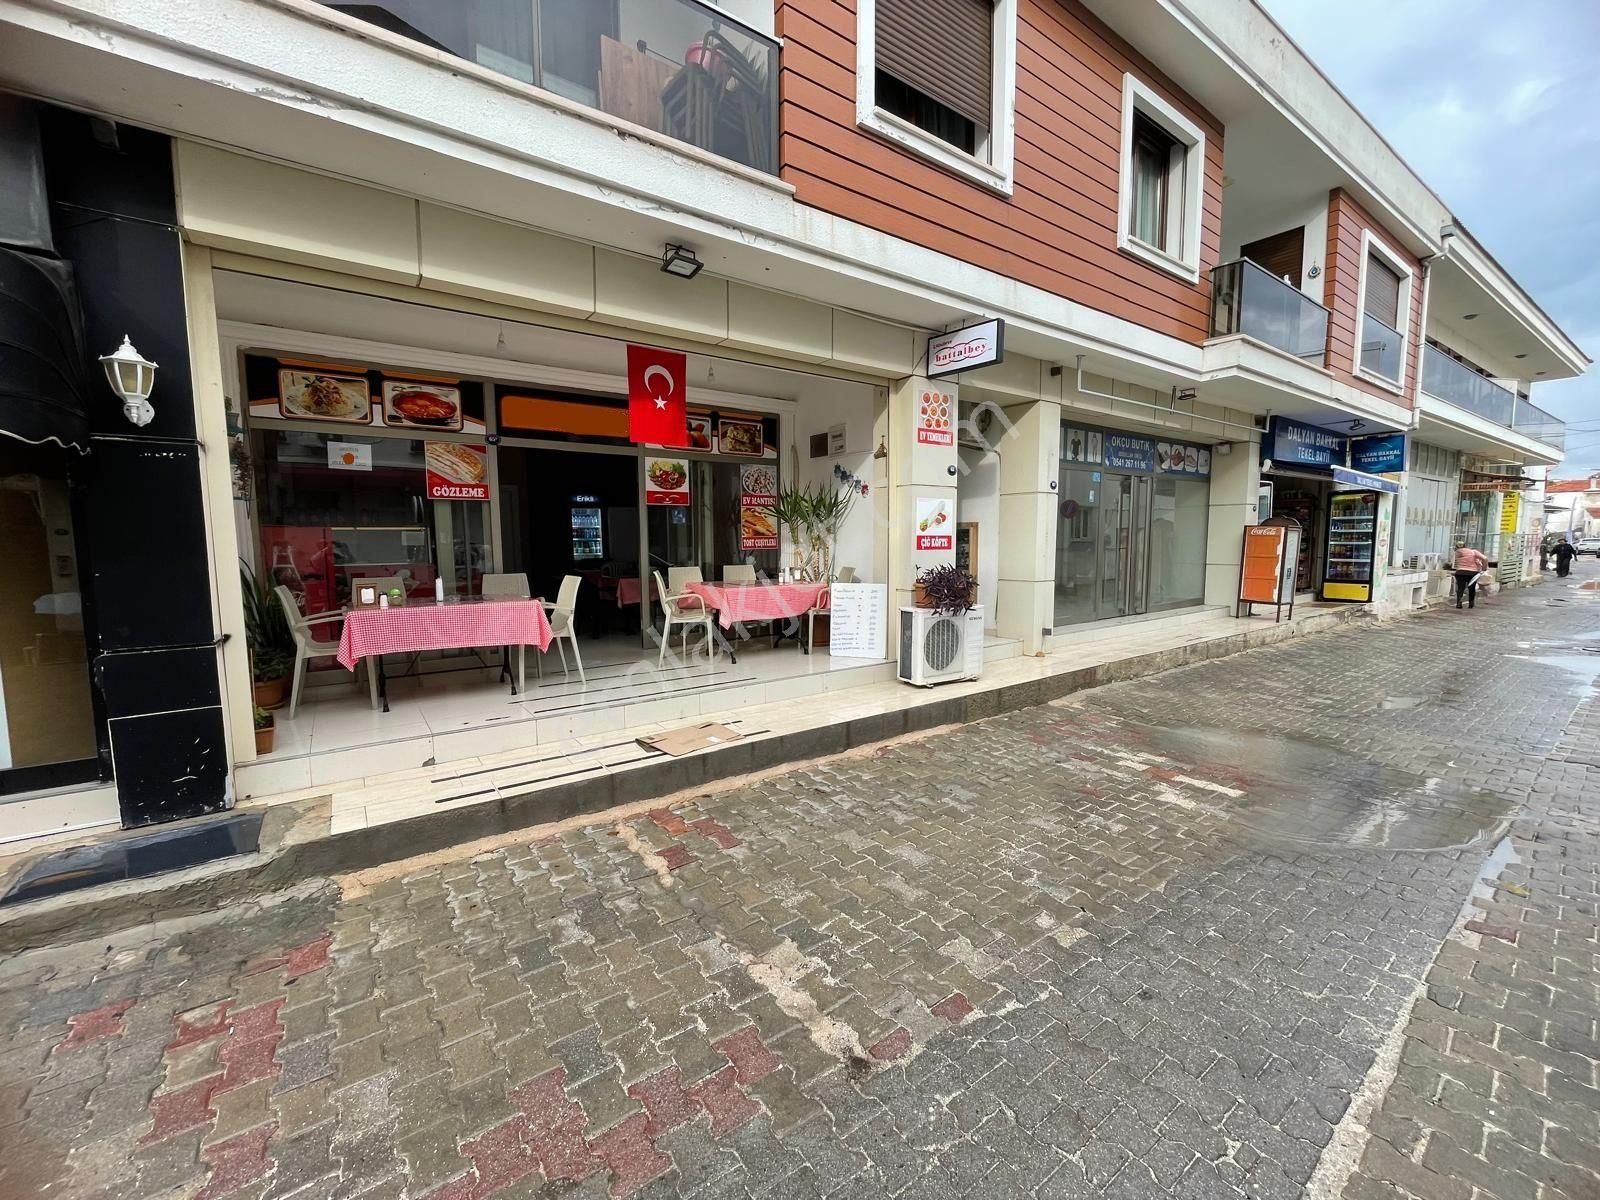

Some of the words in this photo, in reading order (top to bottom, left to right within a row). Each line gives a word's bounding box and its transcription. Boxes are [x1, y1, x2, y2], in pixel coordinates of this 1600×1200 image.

[935, 344, 986, 362] battalbey
[1288, 426, 1315, 445] DALYAN
[1316, 433, 1339, 450] BAKKAL
[1298, 447, 1314, 460] TEKEL
[432, 485, 485, 498] GÖZLEME
[742, 496, 751, 505] EV
[743, 539, 755, 547] TOST
